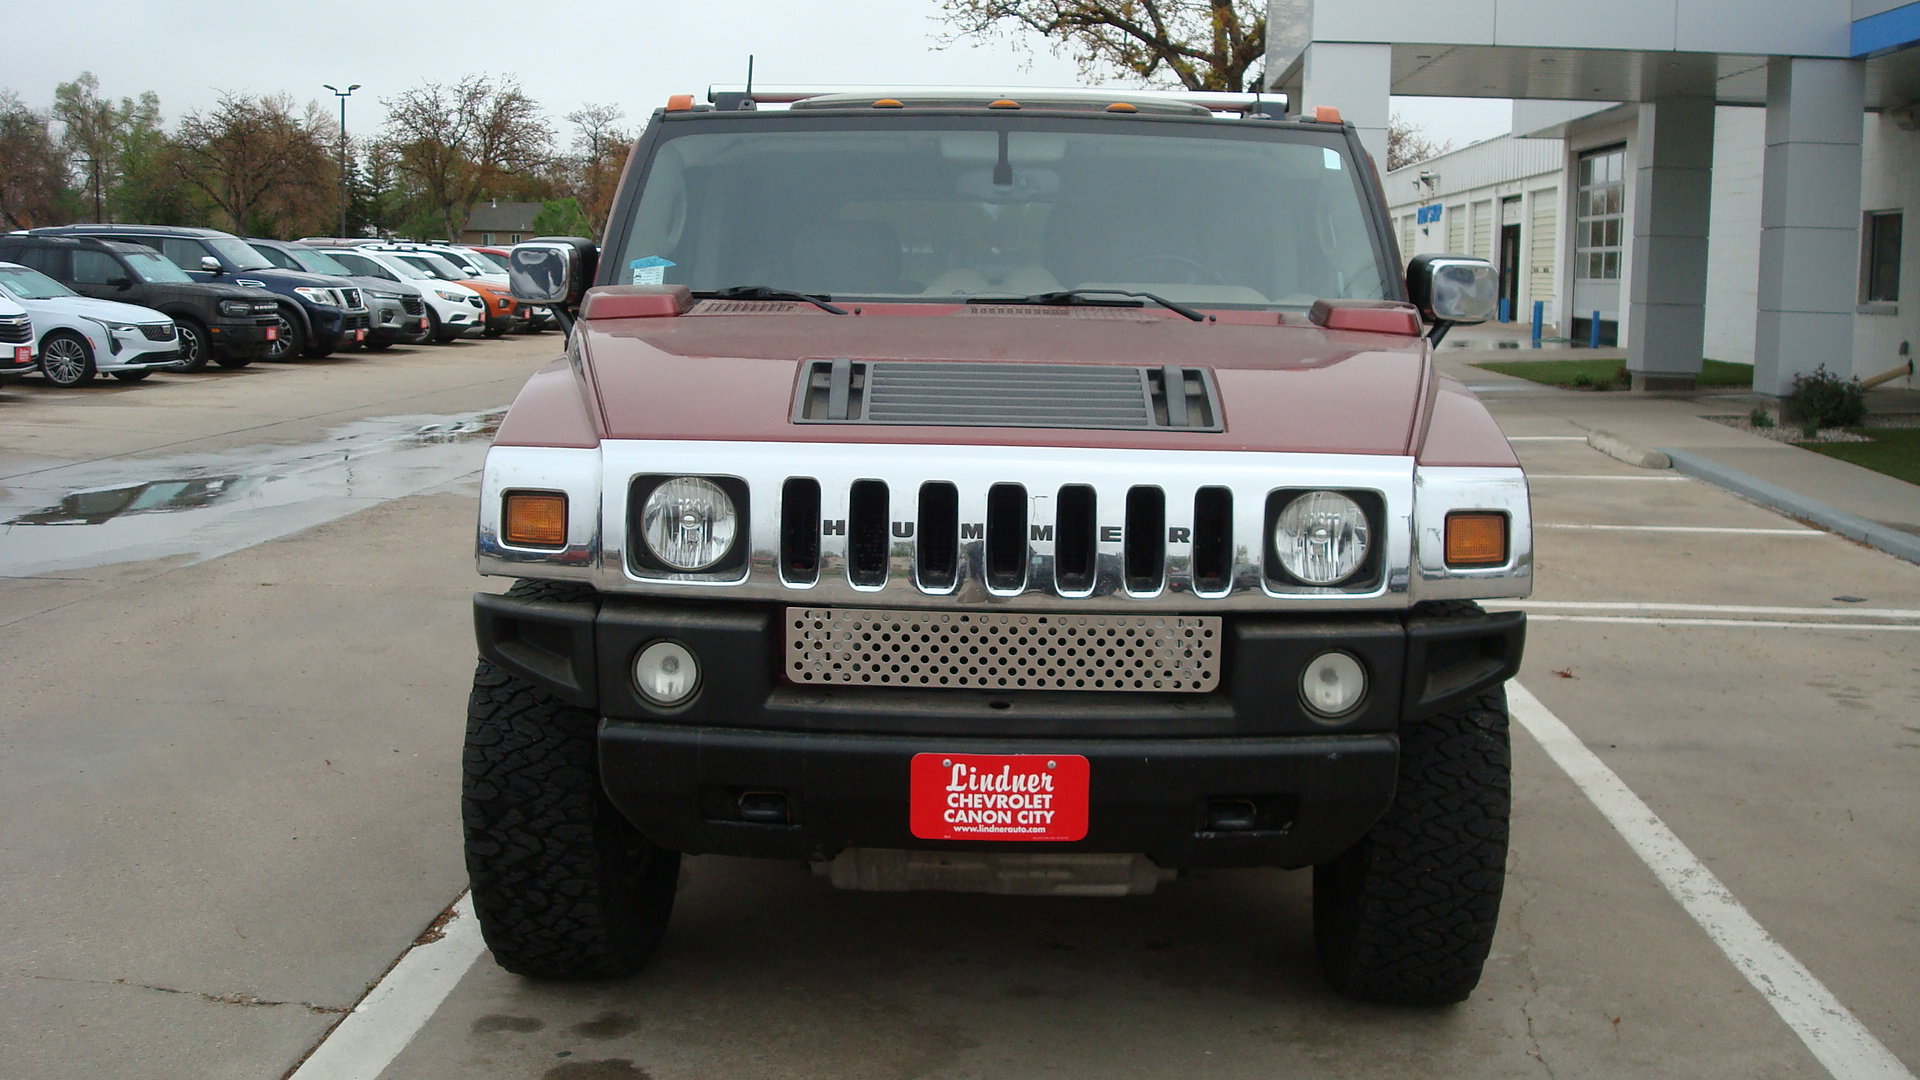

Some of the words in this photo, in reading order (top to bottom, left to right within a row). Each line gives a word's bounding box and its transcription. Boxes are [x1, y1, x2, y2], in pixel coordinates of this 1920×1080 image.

[823, 519, 1191, 544] HUMMER
[945, 763, 1055, 793] Lindner
[947, 793, 1053, 809] CHEVROLET
[944, 809, 1012, 824] CANON
[1017, 810, 1055, 825] CITY
[953, 825, 1046, 834] www.lindnerauto.com
